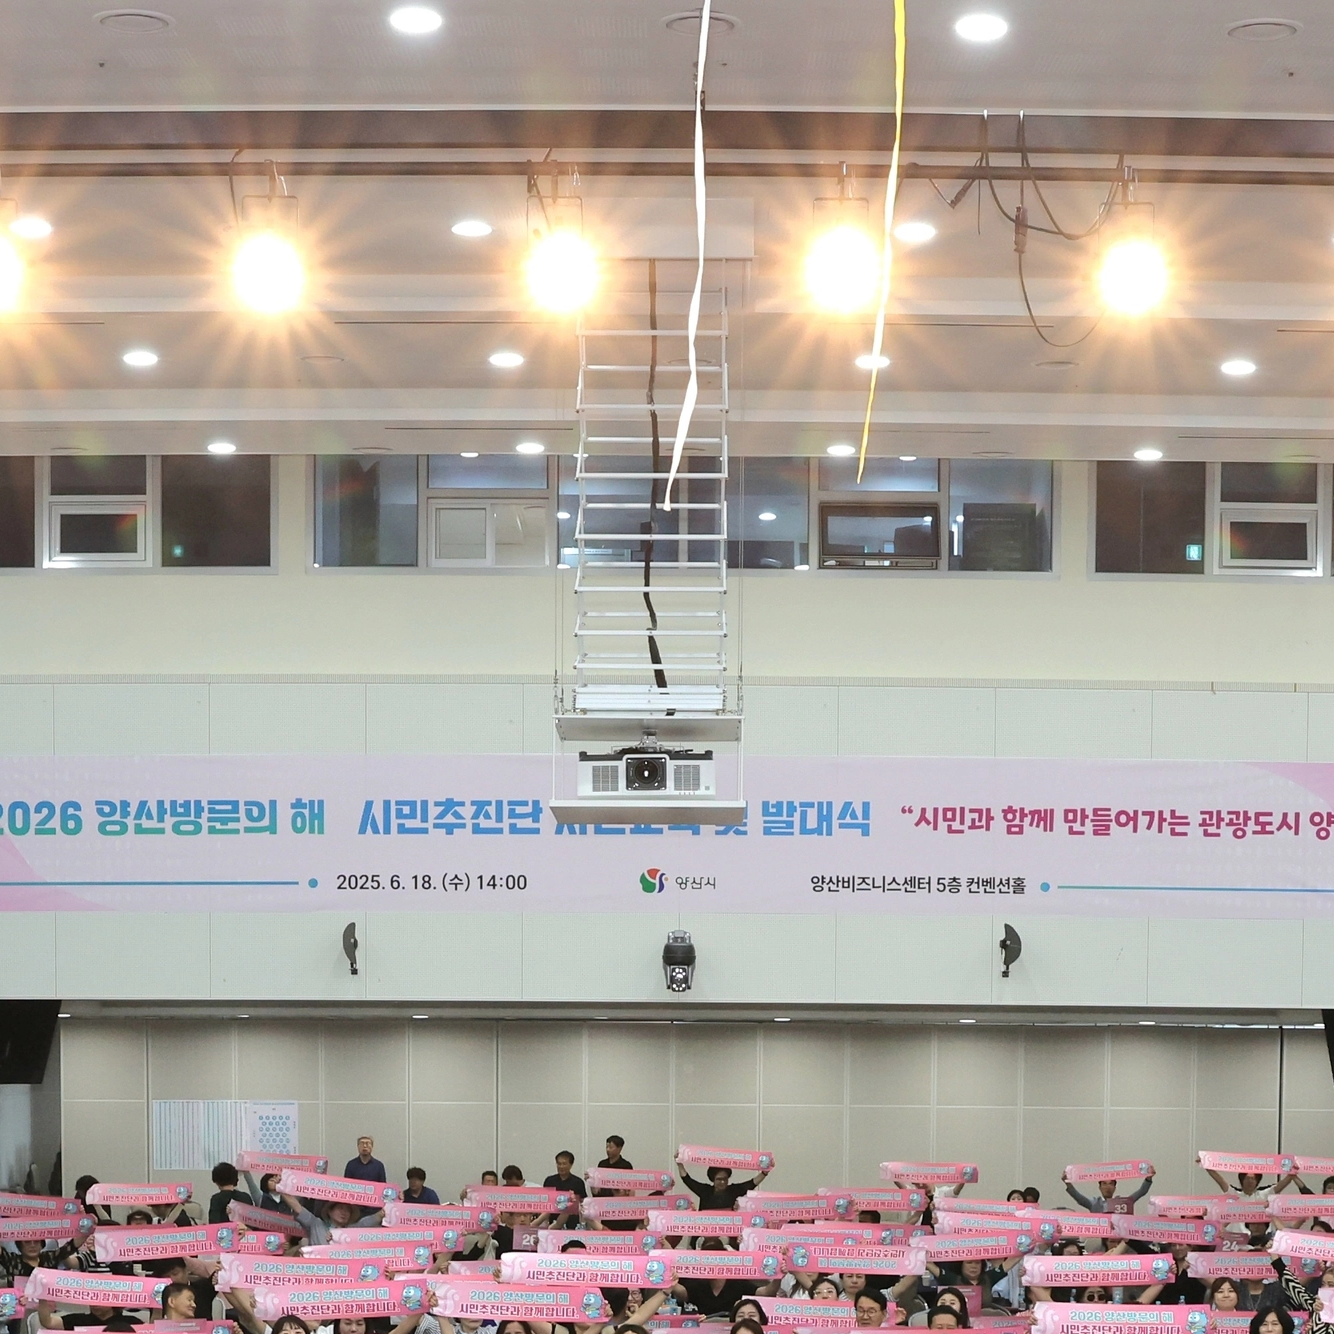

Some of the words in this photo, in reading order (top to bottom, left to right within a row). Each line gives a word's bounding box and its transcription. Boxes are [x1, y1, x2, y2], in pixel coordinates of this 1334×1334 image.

[94, 798, 277, 836] 양산방문의
[290, 797, 325, 835] 해
[358, 798, 543, 836] 시민추진단
[761, 799, 871, 838] 발대식
[1001, 806, 1055, 836] 함께
[1063, 807, 1191, 837] 만들어가는
[1198, 809, 1301, 838] 관광도시
[337, 874, 387, 891] 2025.
[390, 874, 407, 891] 6.
[411, 874, 437, 891] 18.
[441, 873, 471, 893] (수)
[477, 874, 527, 891] 14:00
[675, 875, 717, 891] 양산시
[810, 874, 931, 894] 양산비즈니스센터
[936, 875, 962, 894] 5층
[965, 875, 1027, 895] 컨벤션홀
